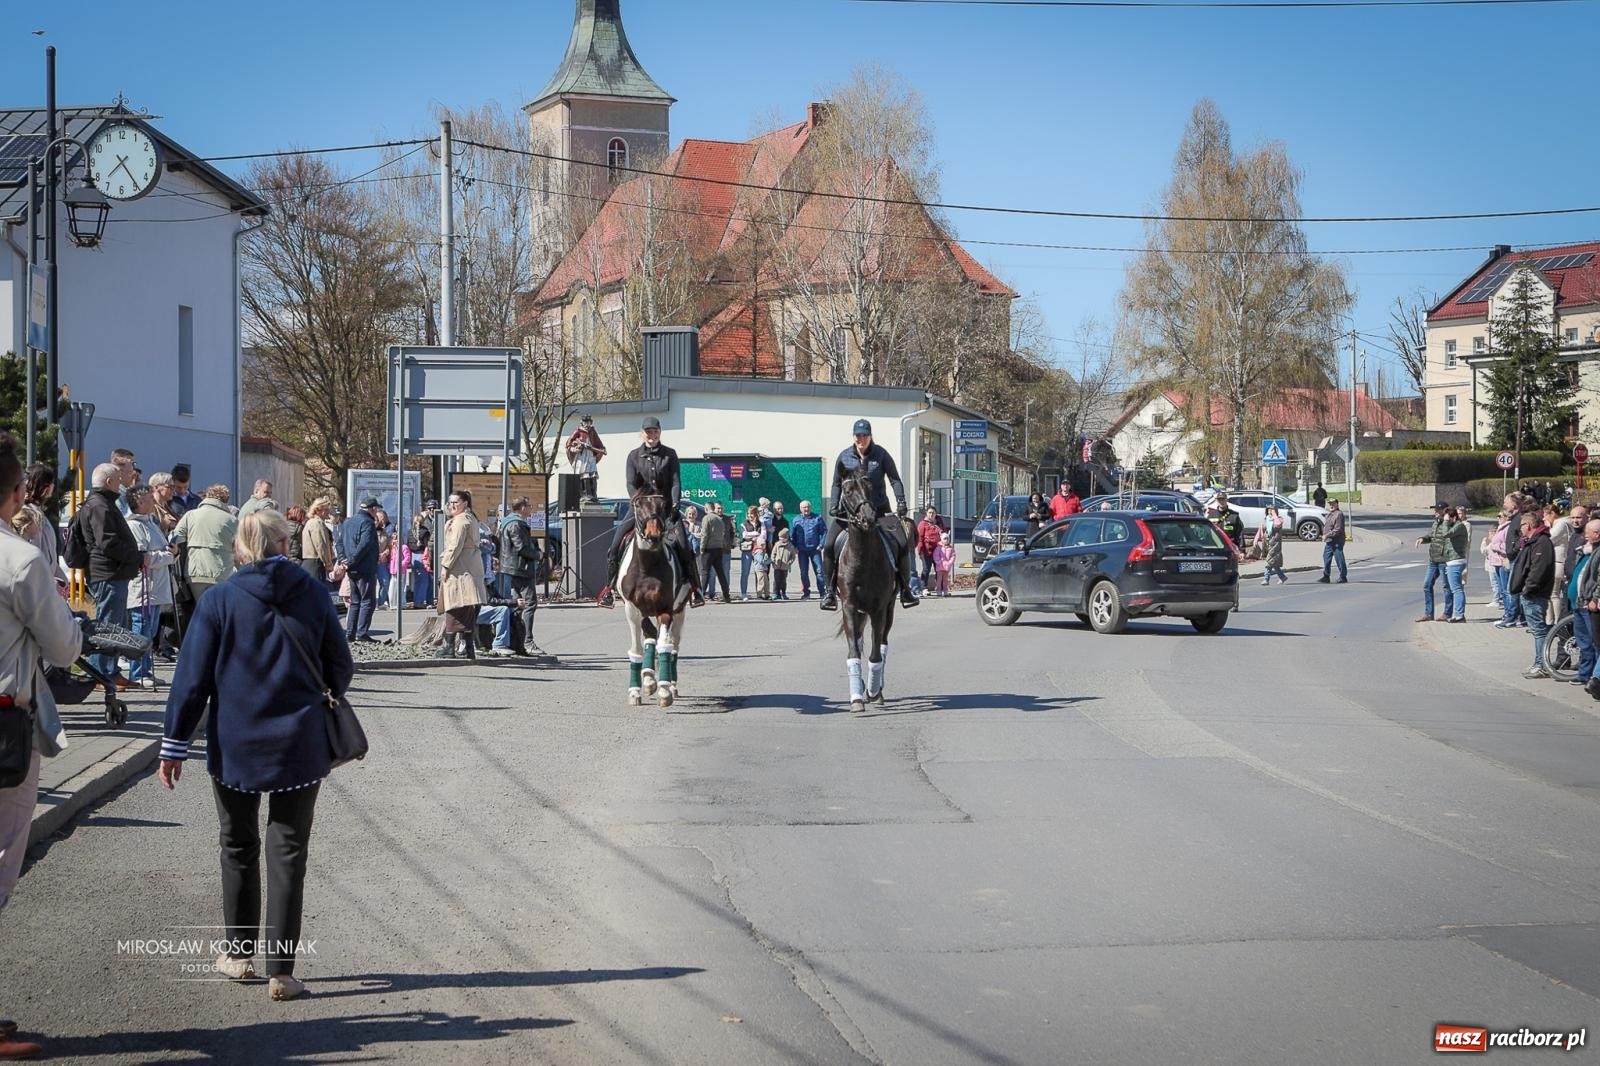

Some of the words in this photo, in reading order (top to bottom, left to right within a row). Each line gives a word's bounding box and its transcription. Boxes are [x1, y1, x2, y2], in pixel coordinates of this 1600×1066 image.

[106, 134, 112, 142] 11
[119, 130, 126, 140] 12
[134, 134, 137, 142] 1
[95, 144, 103, 153] 10
[144, 142, 149, 152] 2
[90, 158, 96, 167] 9
[148, 158, 154, 167] 3
[96, 172, 100, 182] 8
[143, 172, 149, 181] 4
[106, 182, 110, 191] 7
[119, 185, 124, 195] 6
[1500, 456, 1512, 464] 40
[698, 488, 717, 498] box
